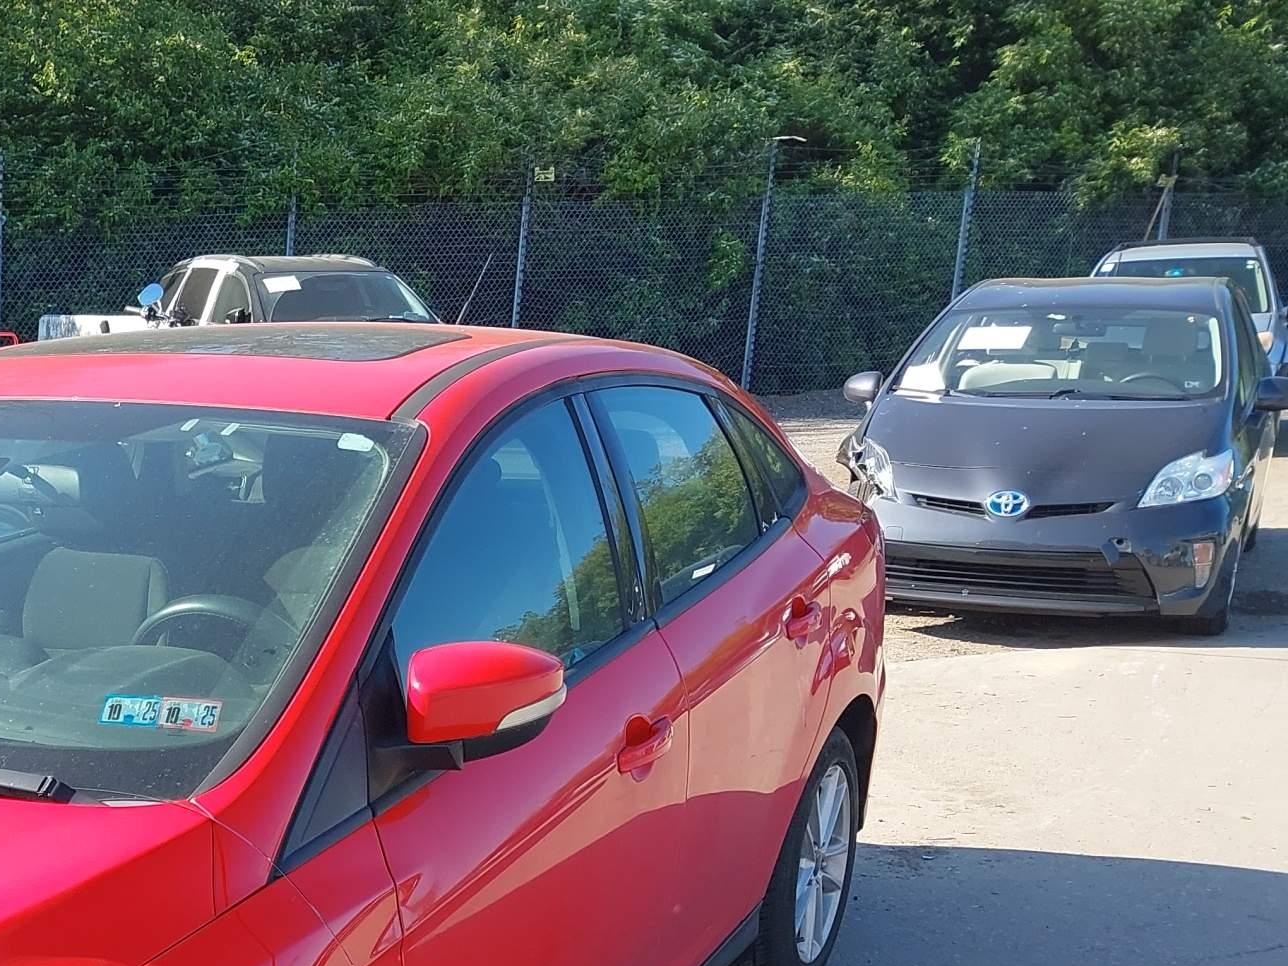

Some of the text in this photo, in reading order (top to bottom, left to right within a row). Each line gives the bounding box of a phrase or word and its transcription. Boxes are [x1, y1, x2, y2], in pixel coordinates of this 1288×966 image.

[108, 701, 159, 721] 10 25
[166, 705, 218, 726] 10 25
